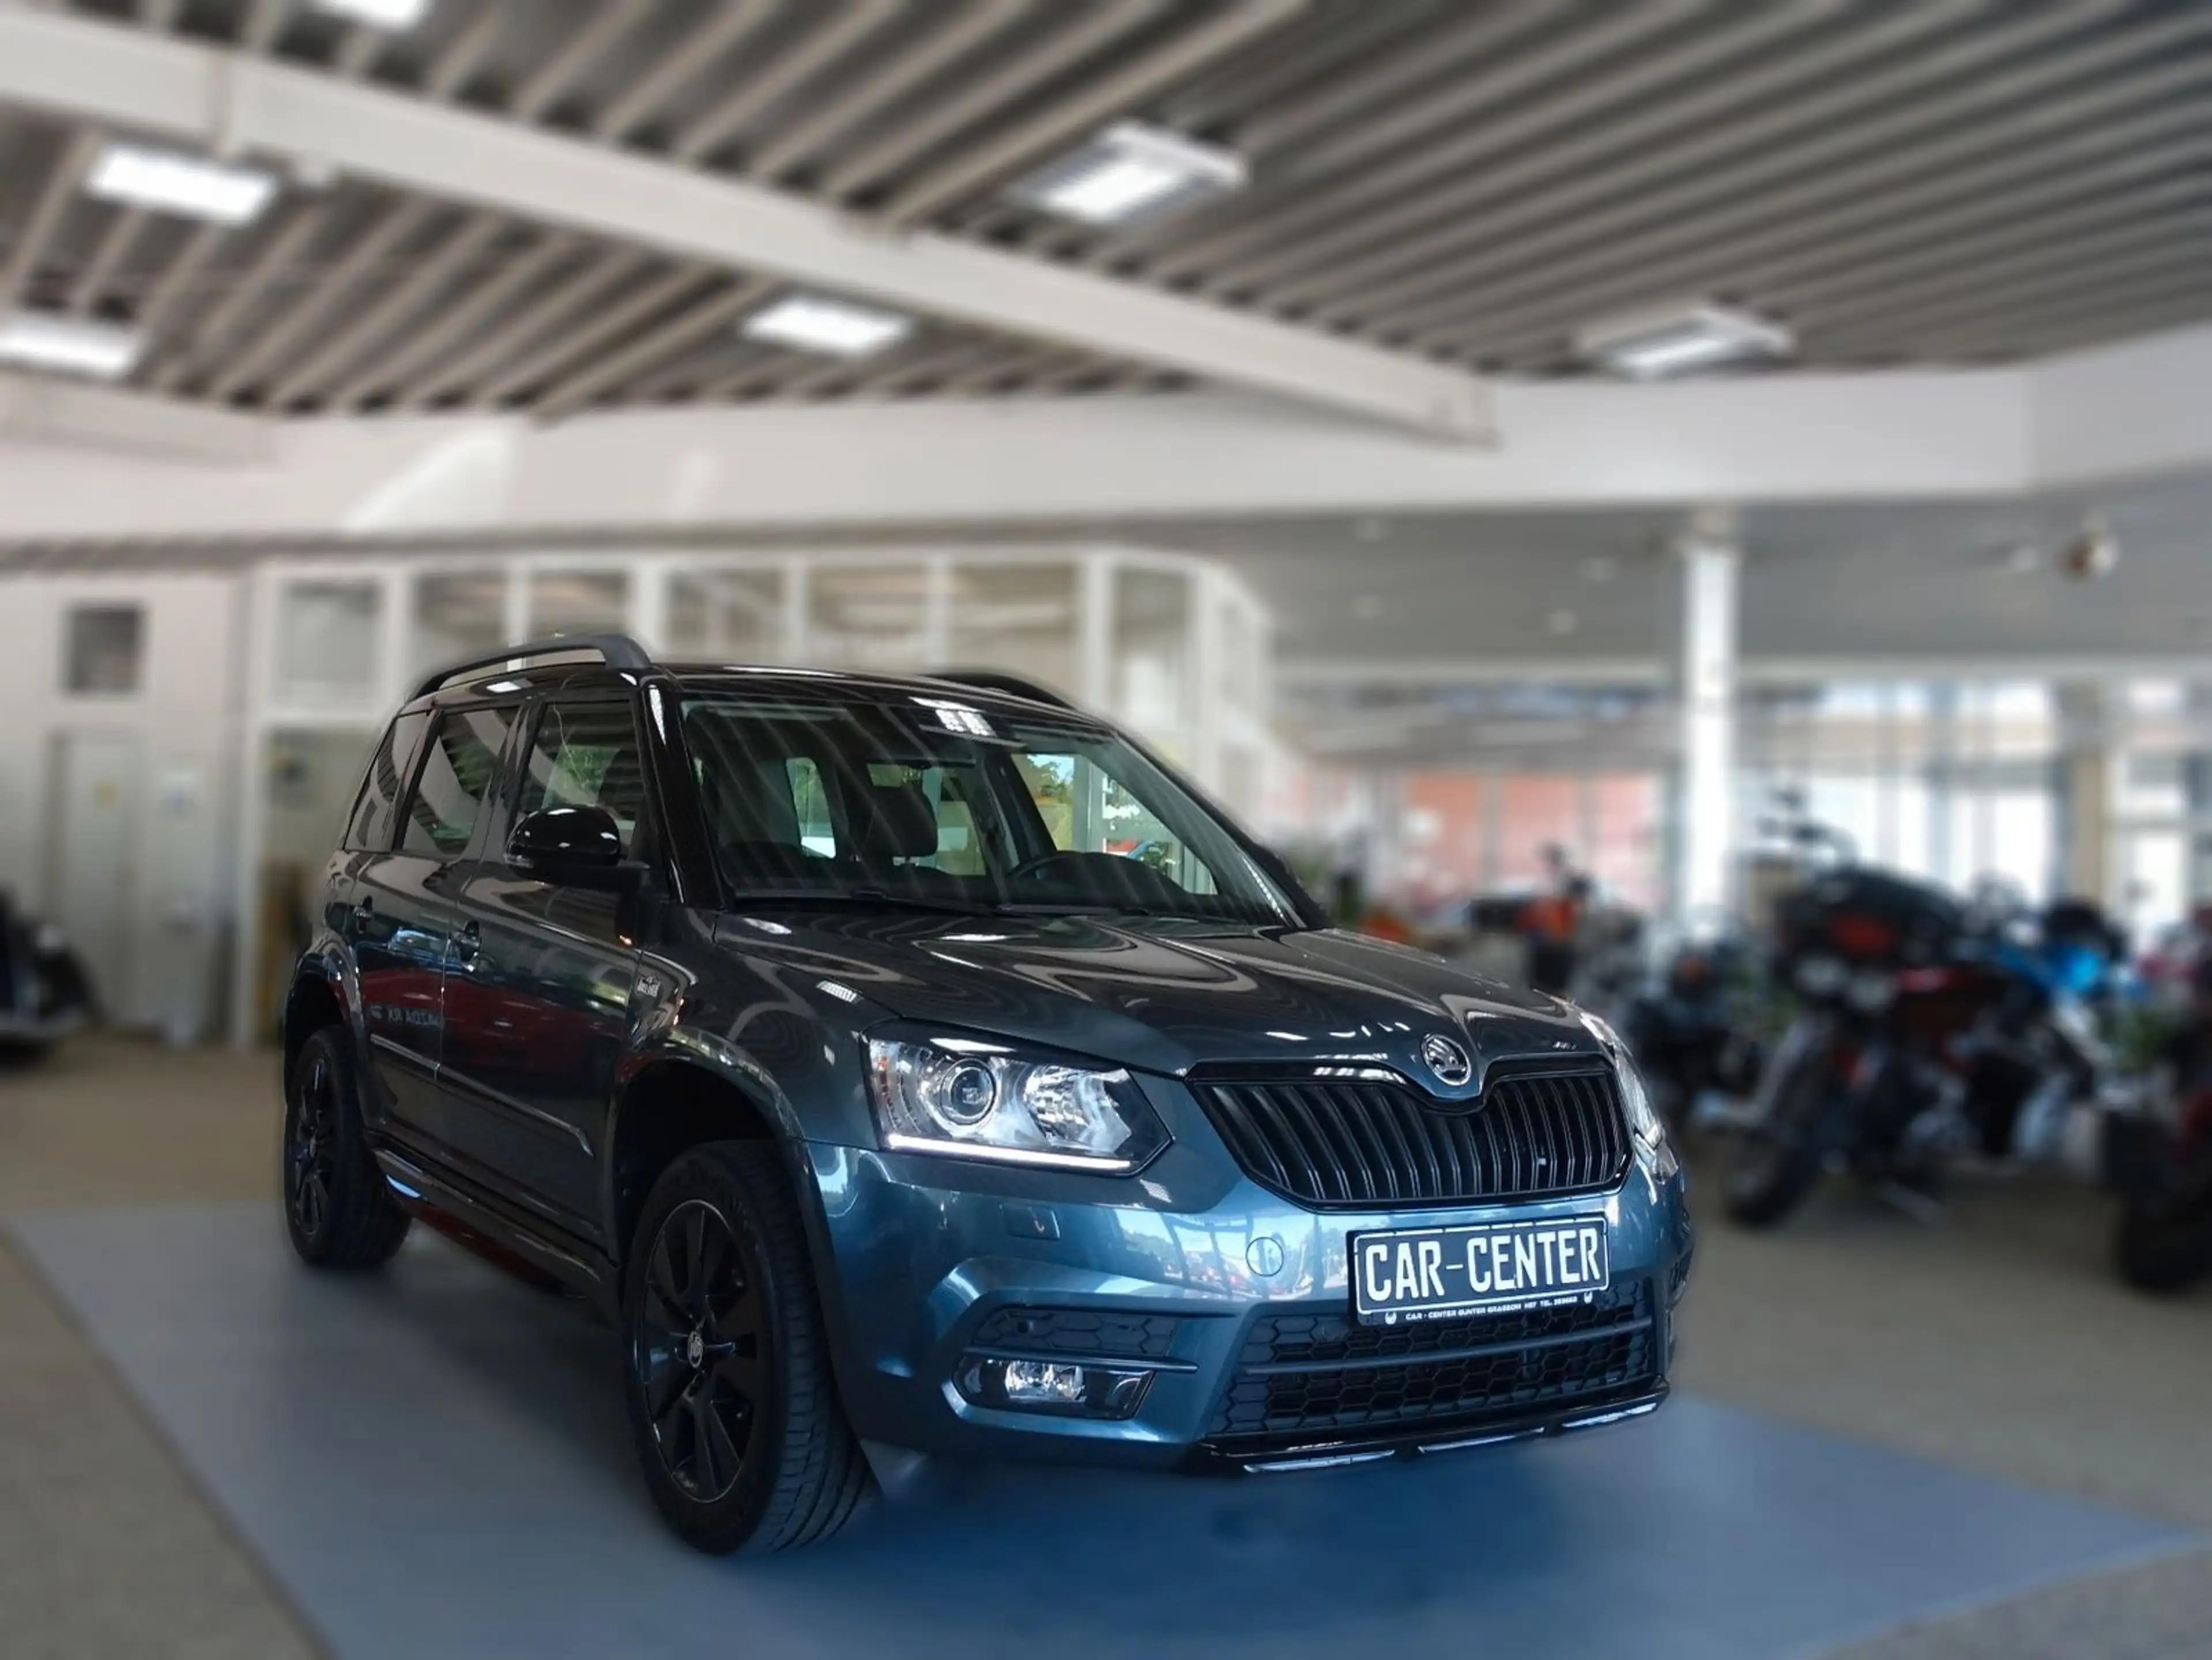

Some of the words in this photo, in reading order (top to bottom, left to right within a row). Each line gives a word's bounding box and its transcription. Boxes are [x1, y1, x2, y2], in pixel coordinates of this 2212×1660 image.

[1365, 1228, 1600, 1301] CAR-CENTER
[1405, 1312, 1422, 1321] CAR
[1427, 1310, 1456, 1319] CENTER
